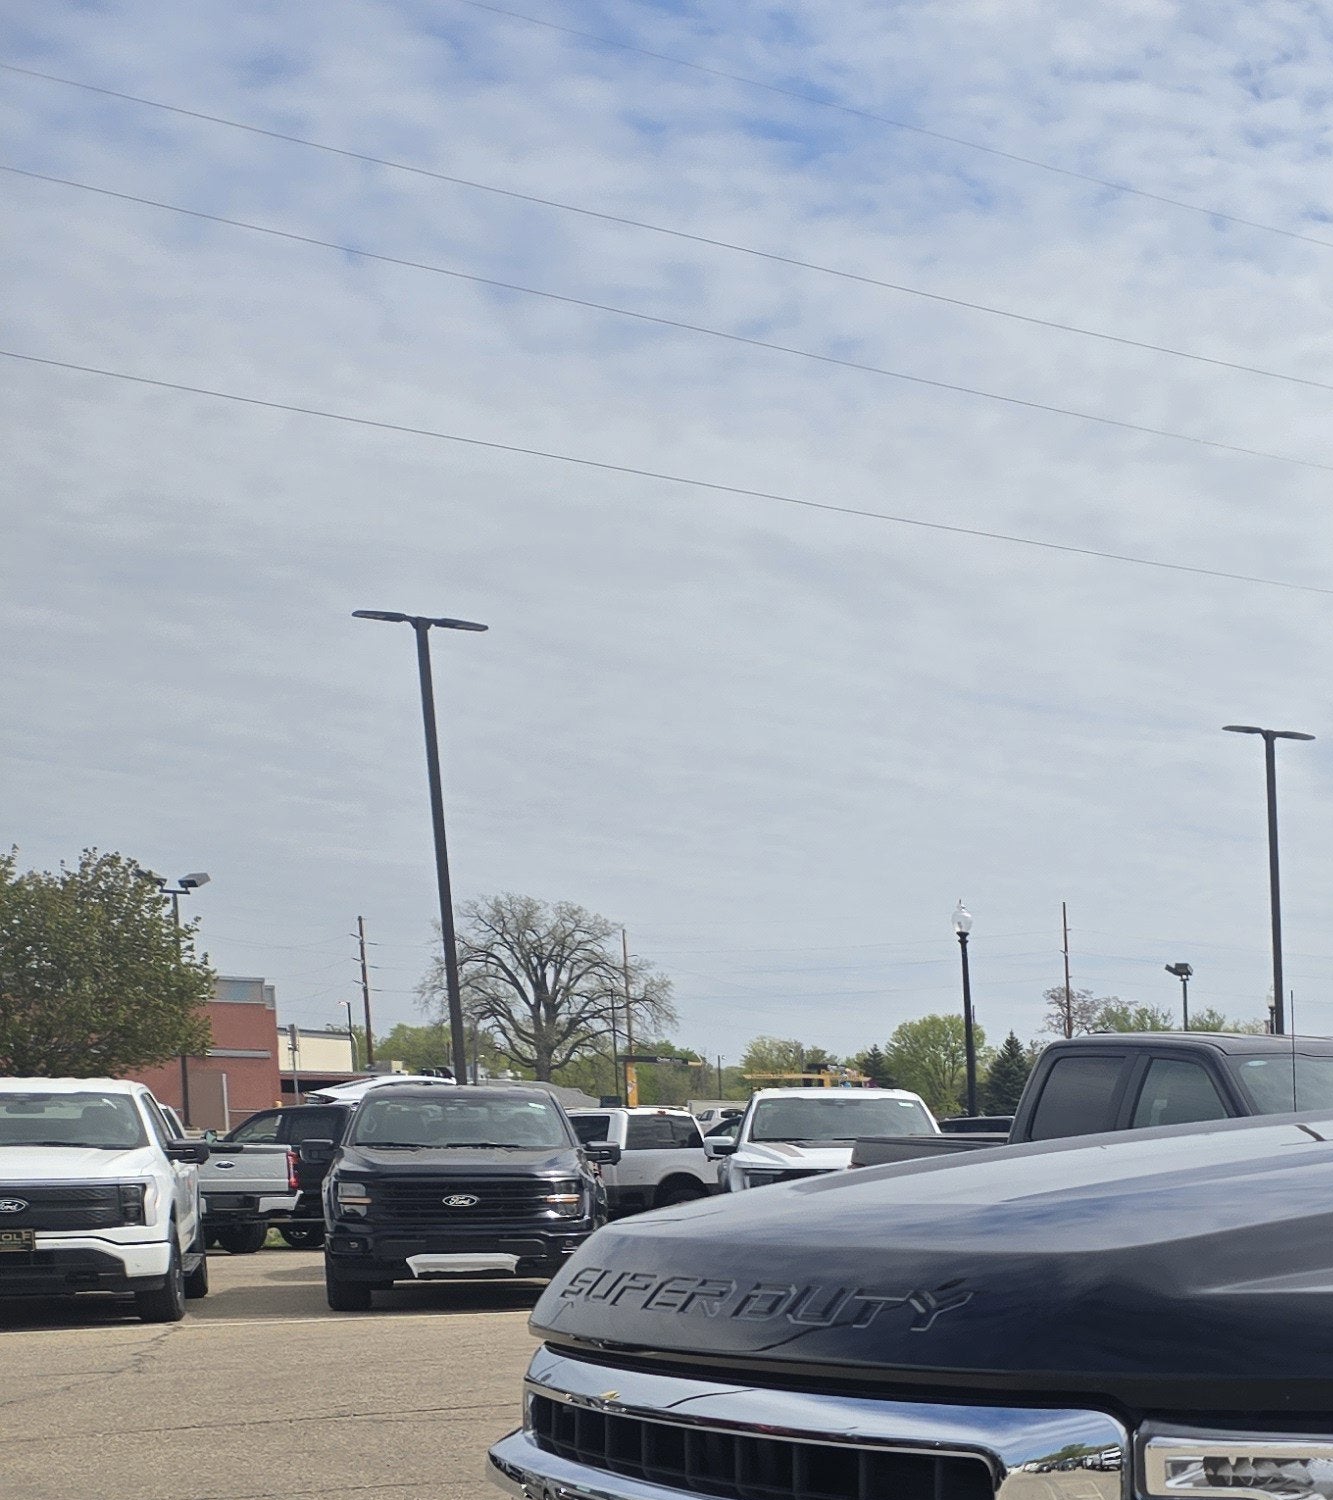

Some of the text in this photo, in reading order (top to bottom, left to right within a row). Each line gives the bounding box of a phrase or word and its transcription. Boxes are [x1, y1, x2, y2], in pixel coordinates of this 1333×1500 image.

[0, 1232, 31, 1242] OLF
[560, 1267, 974, 1332] SUPER DUTY
